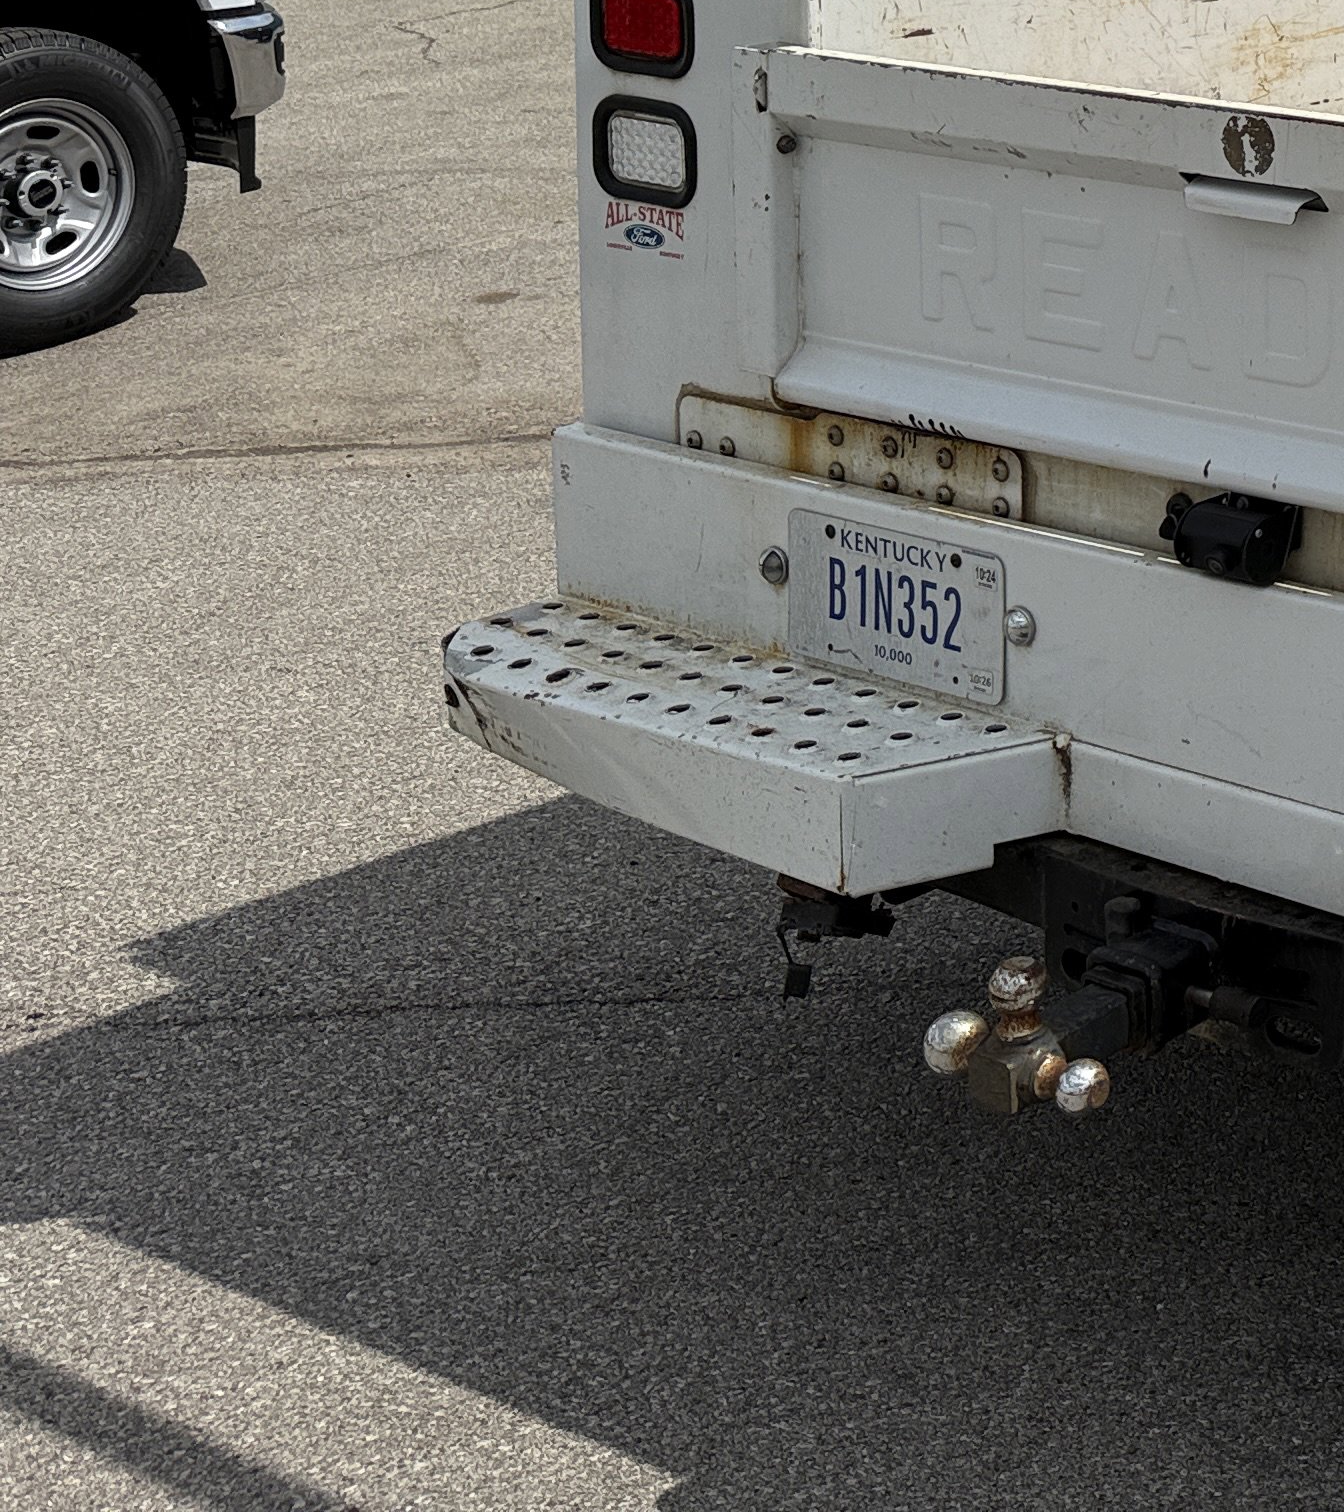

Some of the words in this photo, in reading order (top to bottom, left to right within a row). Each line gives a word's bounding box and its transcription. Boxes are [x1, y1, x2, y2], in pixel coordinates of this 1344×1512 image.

[630, 227, 659, 246] Ford
[840, 529, 947, 573] KENTUCKY
[828, 556, 962, 653] B1N352
[874, 644, 913, 665] 10,000
